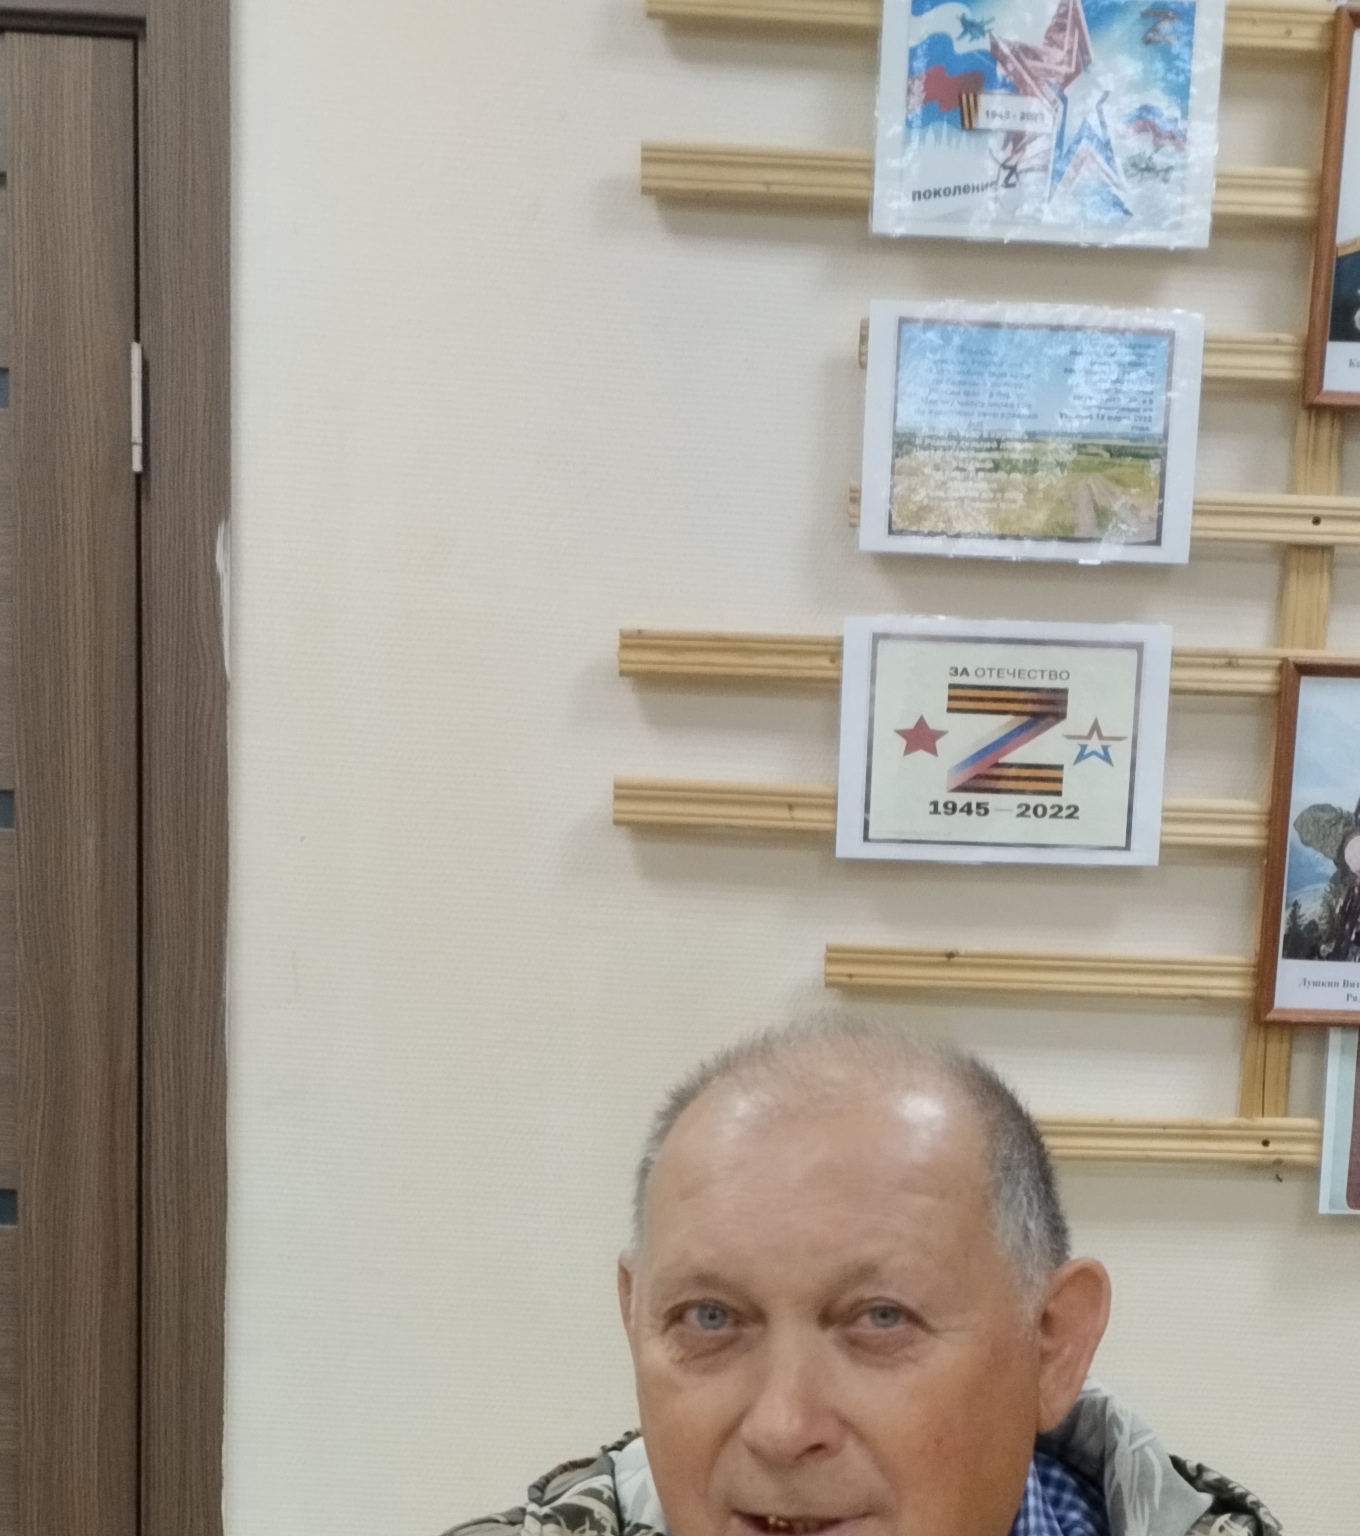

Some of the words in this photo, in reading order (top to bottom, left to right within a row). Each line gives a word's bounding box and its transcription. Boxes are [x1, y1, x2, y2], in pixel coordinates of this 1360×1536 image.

[948, 666, 970, 677] ЗА
[974, 667, 1071, 682] ОТЕЧЕСТВО
[928, 800, 990, 817] 1945
[1016, 803, 1080, 820] 2022
[1299, 978, 1340, 990] Лушкин
